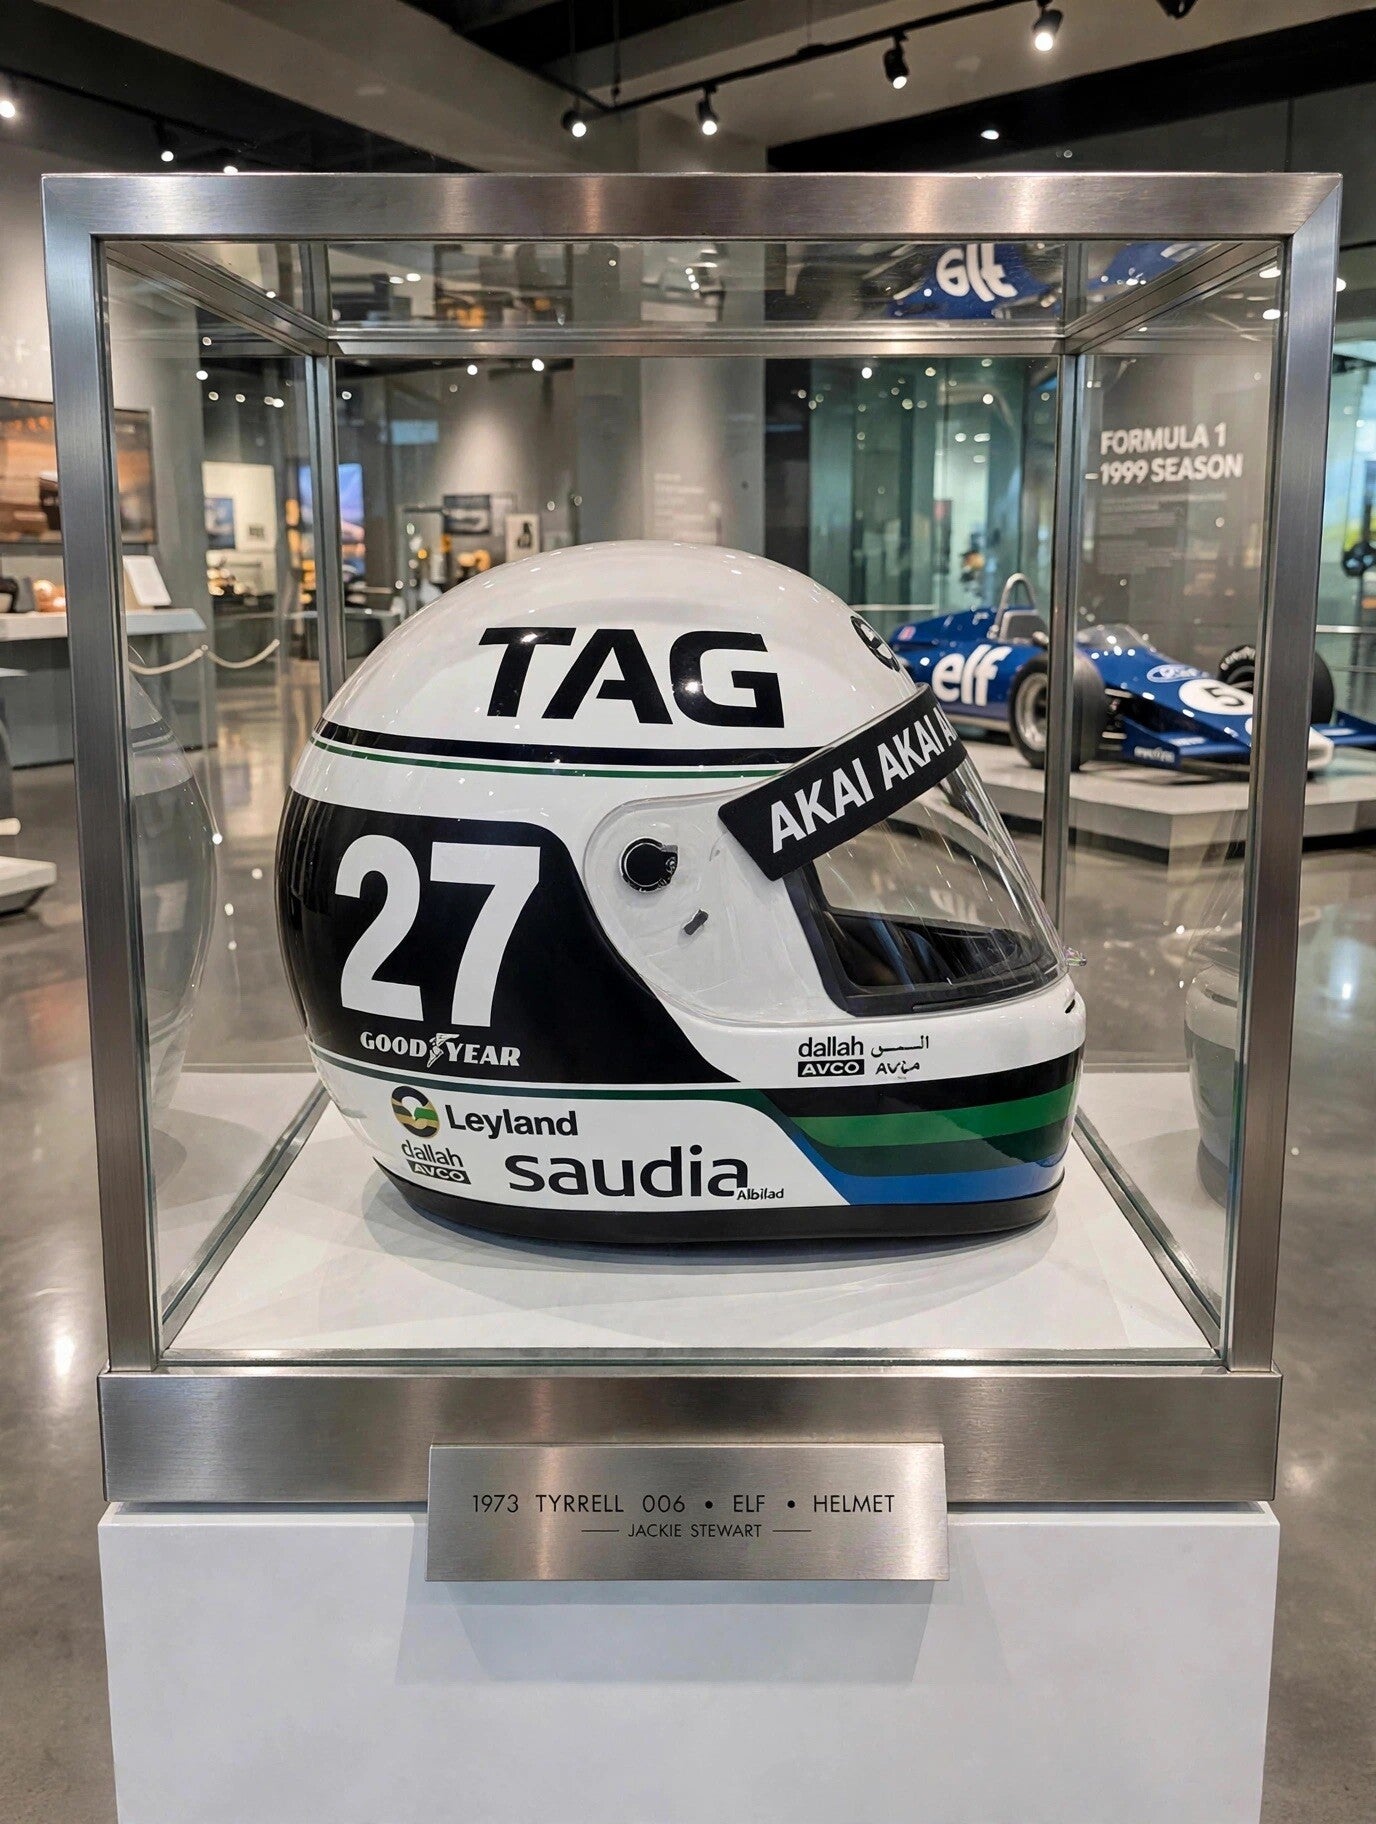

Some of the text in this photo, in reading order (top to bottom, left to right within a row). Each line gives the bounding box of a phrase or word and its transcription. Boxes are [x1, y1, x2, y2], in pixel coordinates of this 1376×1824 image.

[1101, 421, 1227, 455] FORMULA 1
[1100, 453, 1243, 485] 1999 SEASON
[478, 626, 785, 729] TAG
[932, 644, 1012, 707] elf
[1203, 687, 1245, 706] 5
[771, 757, 874, 853] AKAI
[877, 714, 945, 791] AKAI
[335, 834, 541, 1027] 27
[798, 1035, 864, 1057] dallah
[801, 1061, 861, 1076] AVCO
[445, 1104, 579, 1140] Leyland
[401, 1139, 464, 1168] dallah
[413, 1162, 466, 1182] AVCO
[504, 1144, 748, 1198] saudia
[736, 1187, 785, 1201] Albilad
[472, 1494, 895, 1513] 1973 TYRRELL 006 ELF HELMET
[628, 1523, 762, 1538] JACKIE STEWART
